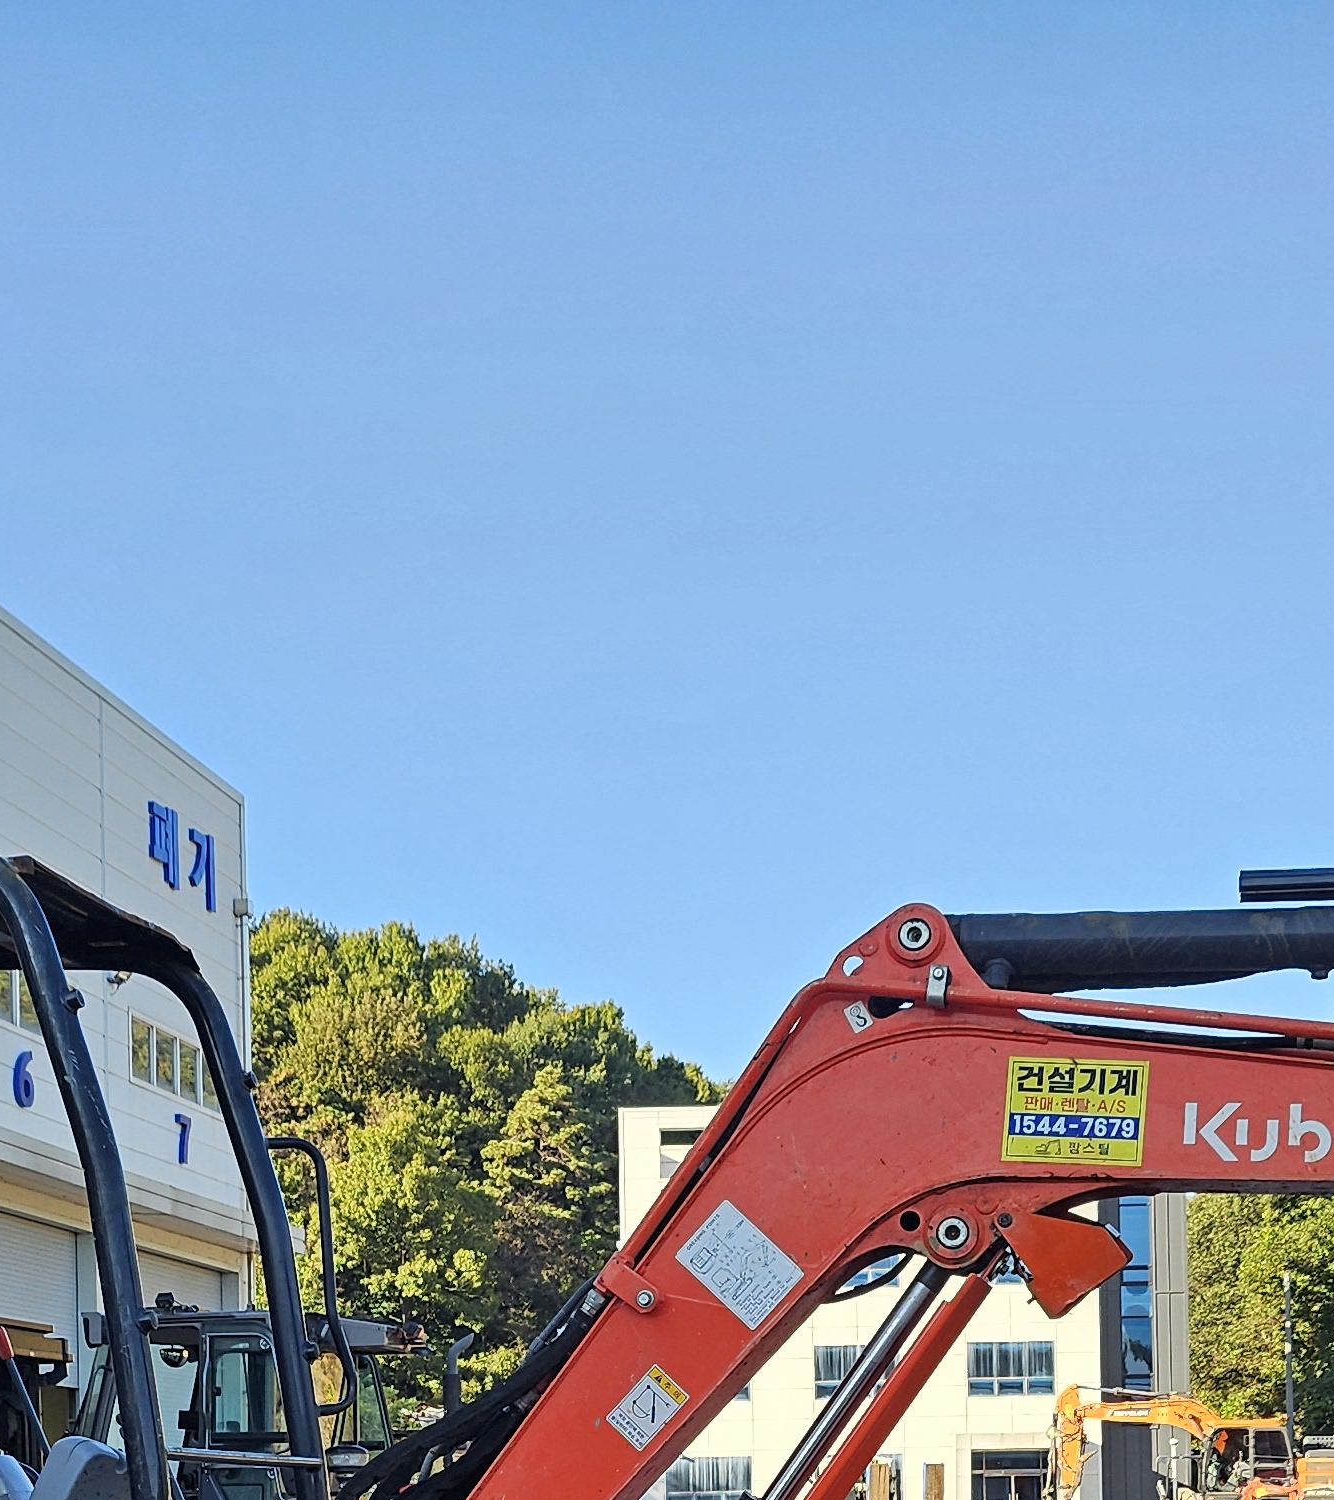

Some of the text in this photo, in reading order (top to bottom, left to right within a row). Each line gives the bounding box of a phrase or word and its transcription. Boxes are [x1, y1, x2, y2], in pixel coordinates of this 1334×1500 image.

[148, 801, 216, 913] 폐기
[13, 1050, 35, 1107] 6
[1017, 1066, 1139, 1096] 건설기계
[175, 1113, 191, 1165] 7
[1013, 1115, 1135, 1138] 1544-7679
